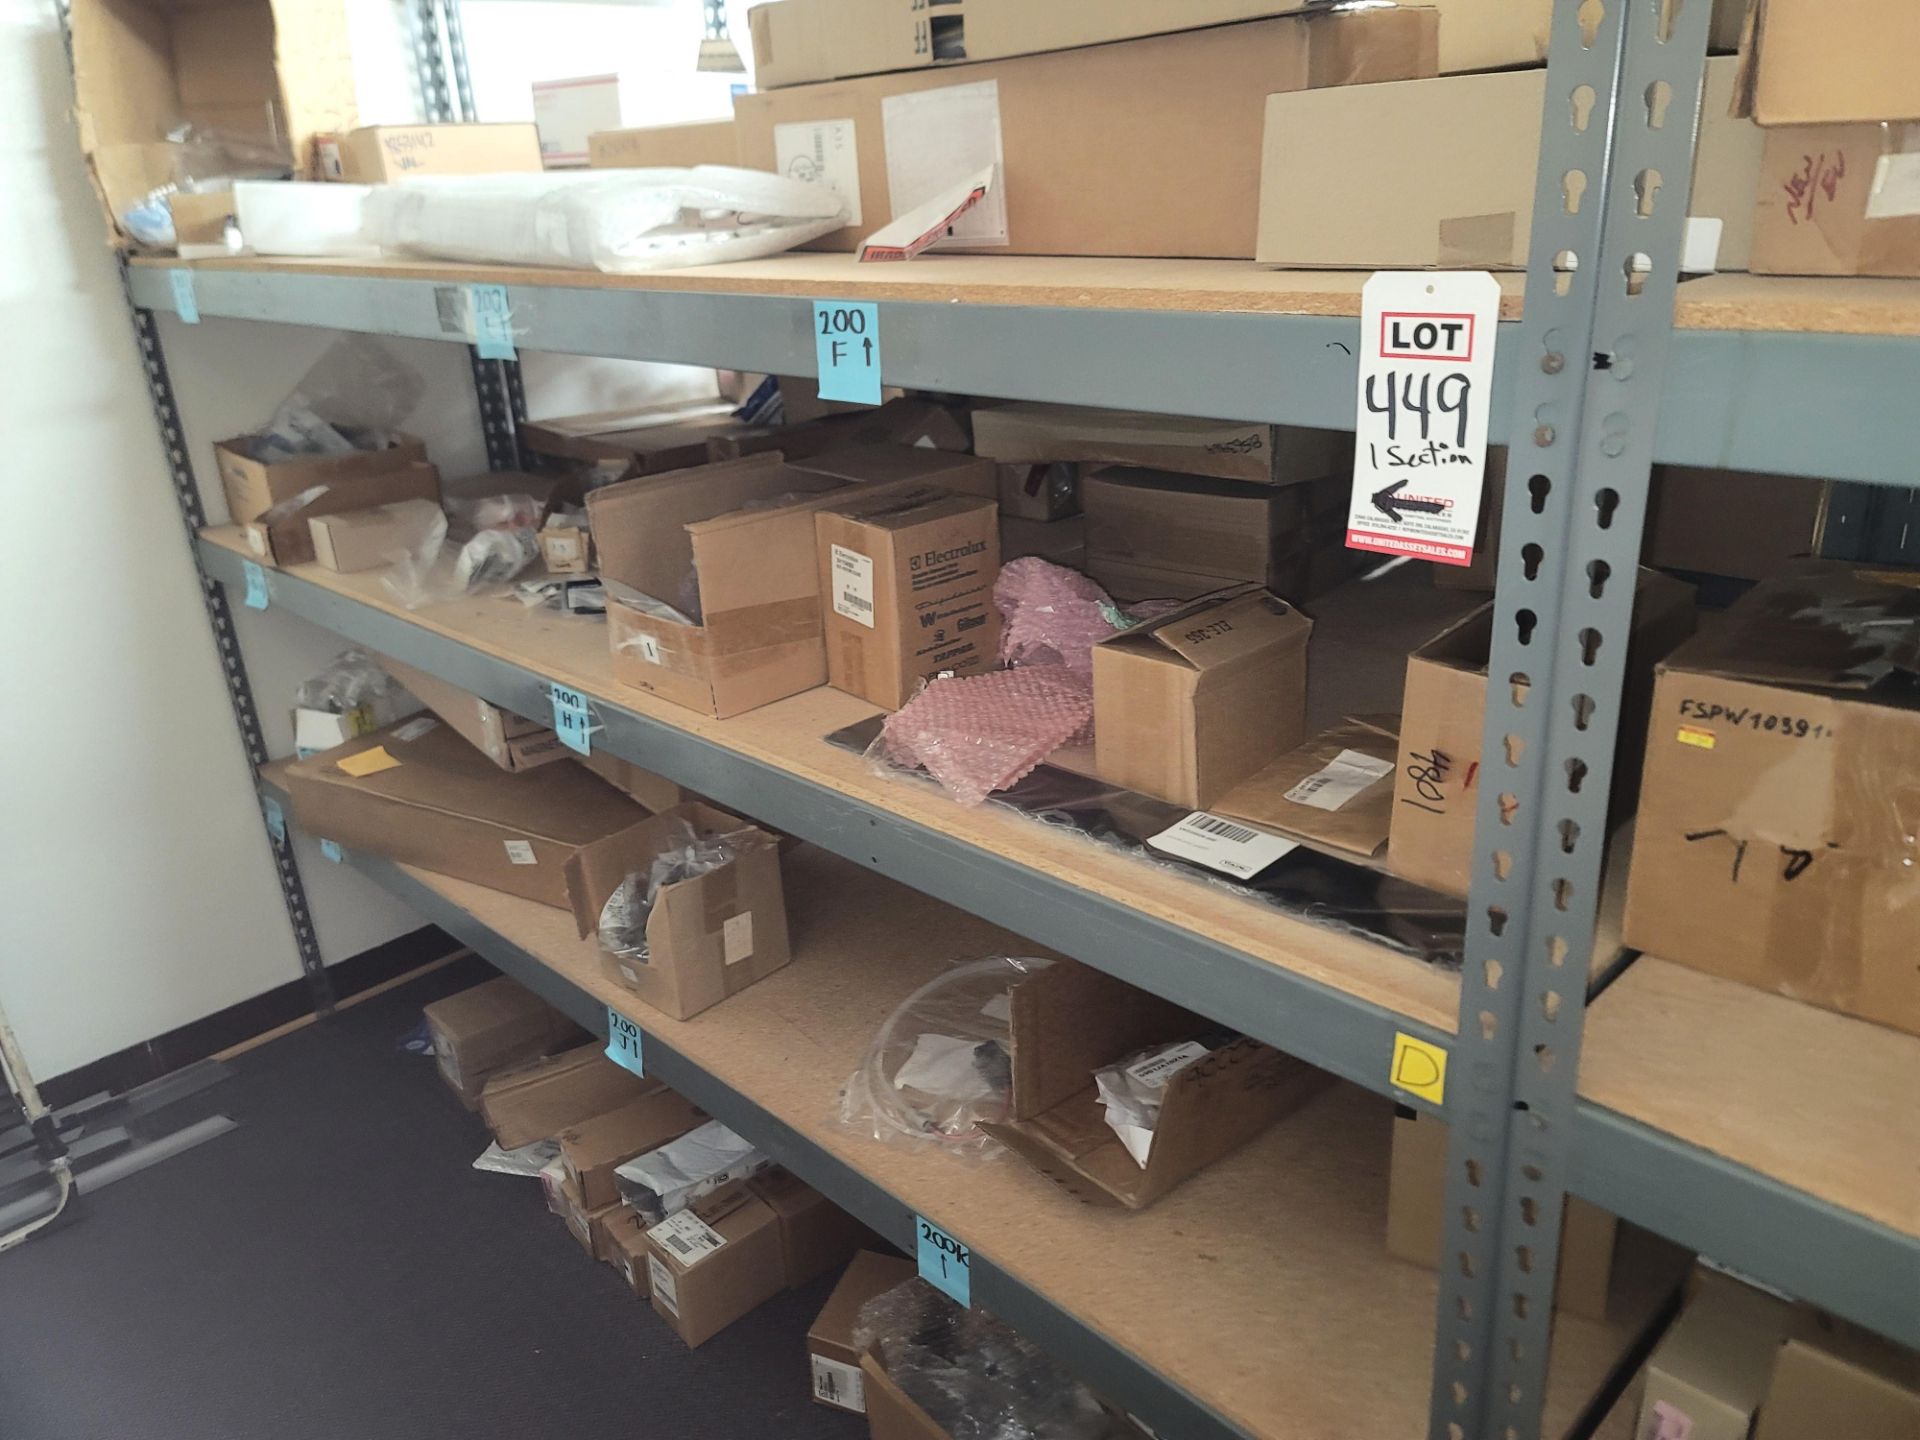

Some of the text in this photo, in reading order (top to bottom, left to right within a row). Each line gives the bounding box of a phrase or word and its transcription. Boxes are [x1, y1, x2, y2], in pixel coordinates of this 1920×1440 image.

[819, 308, 866, 334] 200
[1392, 321, 1464, 351] LOT
[832, 341, 848, 367] F
[1366, 371, 1471, 448] 449
[1386, 441, 1472, 468] Section
[924, 541, 988, 567] Electrolux
[562, 711, 573, 729] H
[611, 1013, 637, 1038] 200
[1396, 1045, 1440, 1087] D
[921, 1223, 969, 1268] 200K
